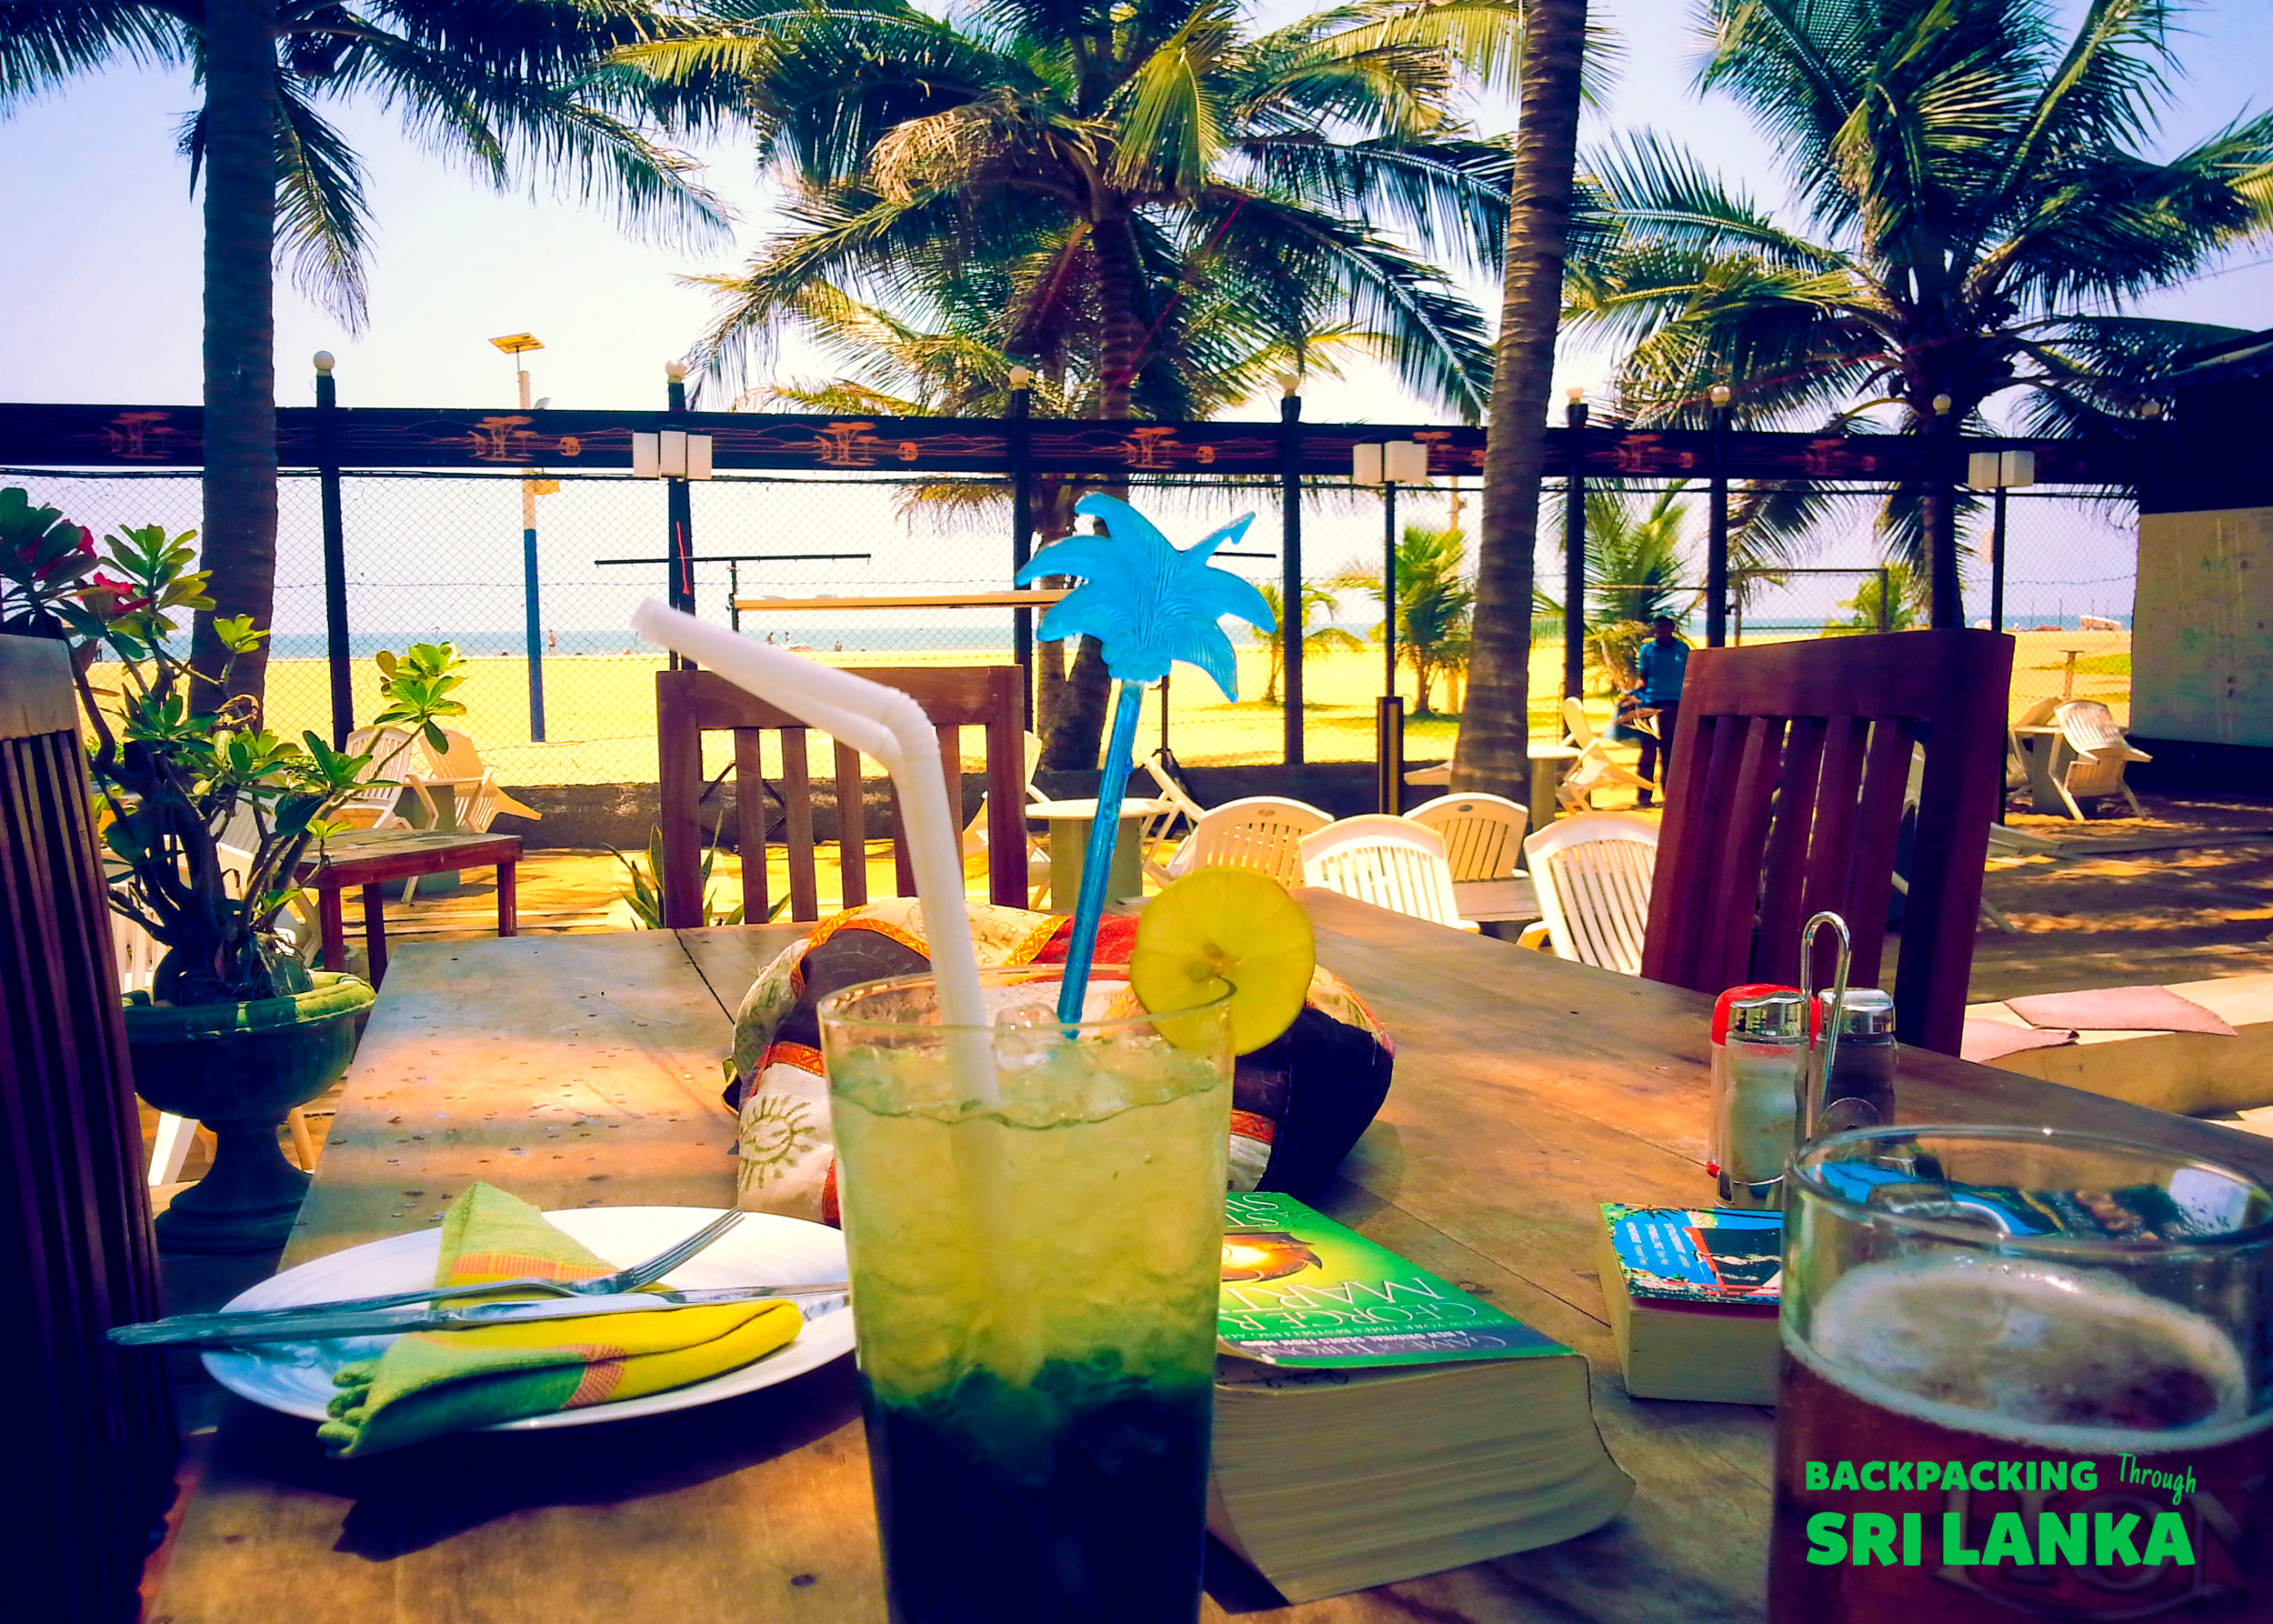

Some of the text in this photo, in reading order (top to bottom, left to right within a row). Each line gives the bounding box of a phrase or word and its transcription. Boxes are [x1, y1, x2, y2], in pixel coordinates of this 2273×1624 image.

[1218, 1278, 1447, 1312] MART
[1265, 1302, 1477, 1329] GEORGE
[1354, 1324, 1398, 1333] TIMES
[1403, 1322, 1446, 1330] YORK
[1364, 1332, 1427, 1342] ORIGINAL
[1427, 1330, 1457, 1338] NEW
[1317, 1336, 1366, 1345] SERIES
[1409, 1335, 1507, 1350] GAME
